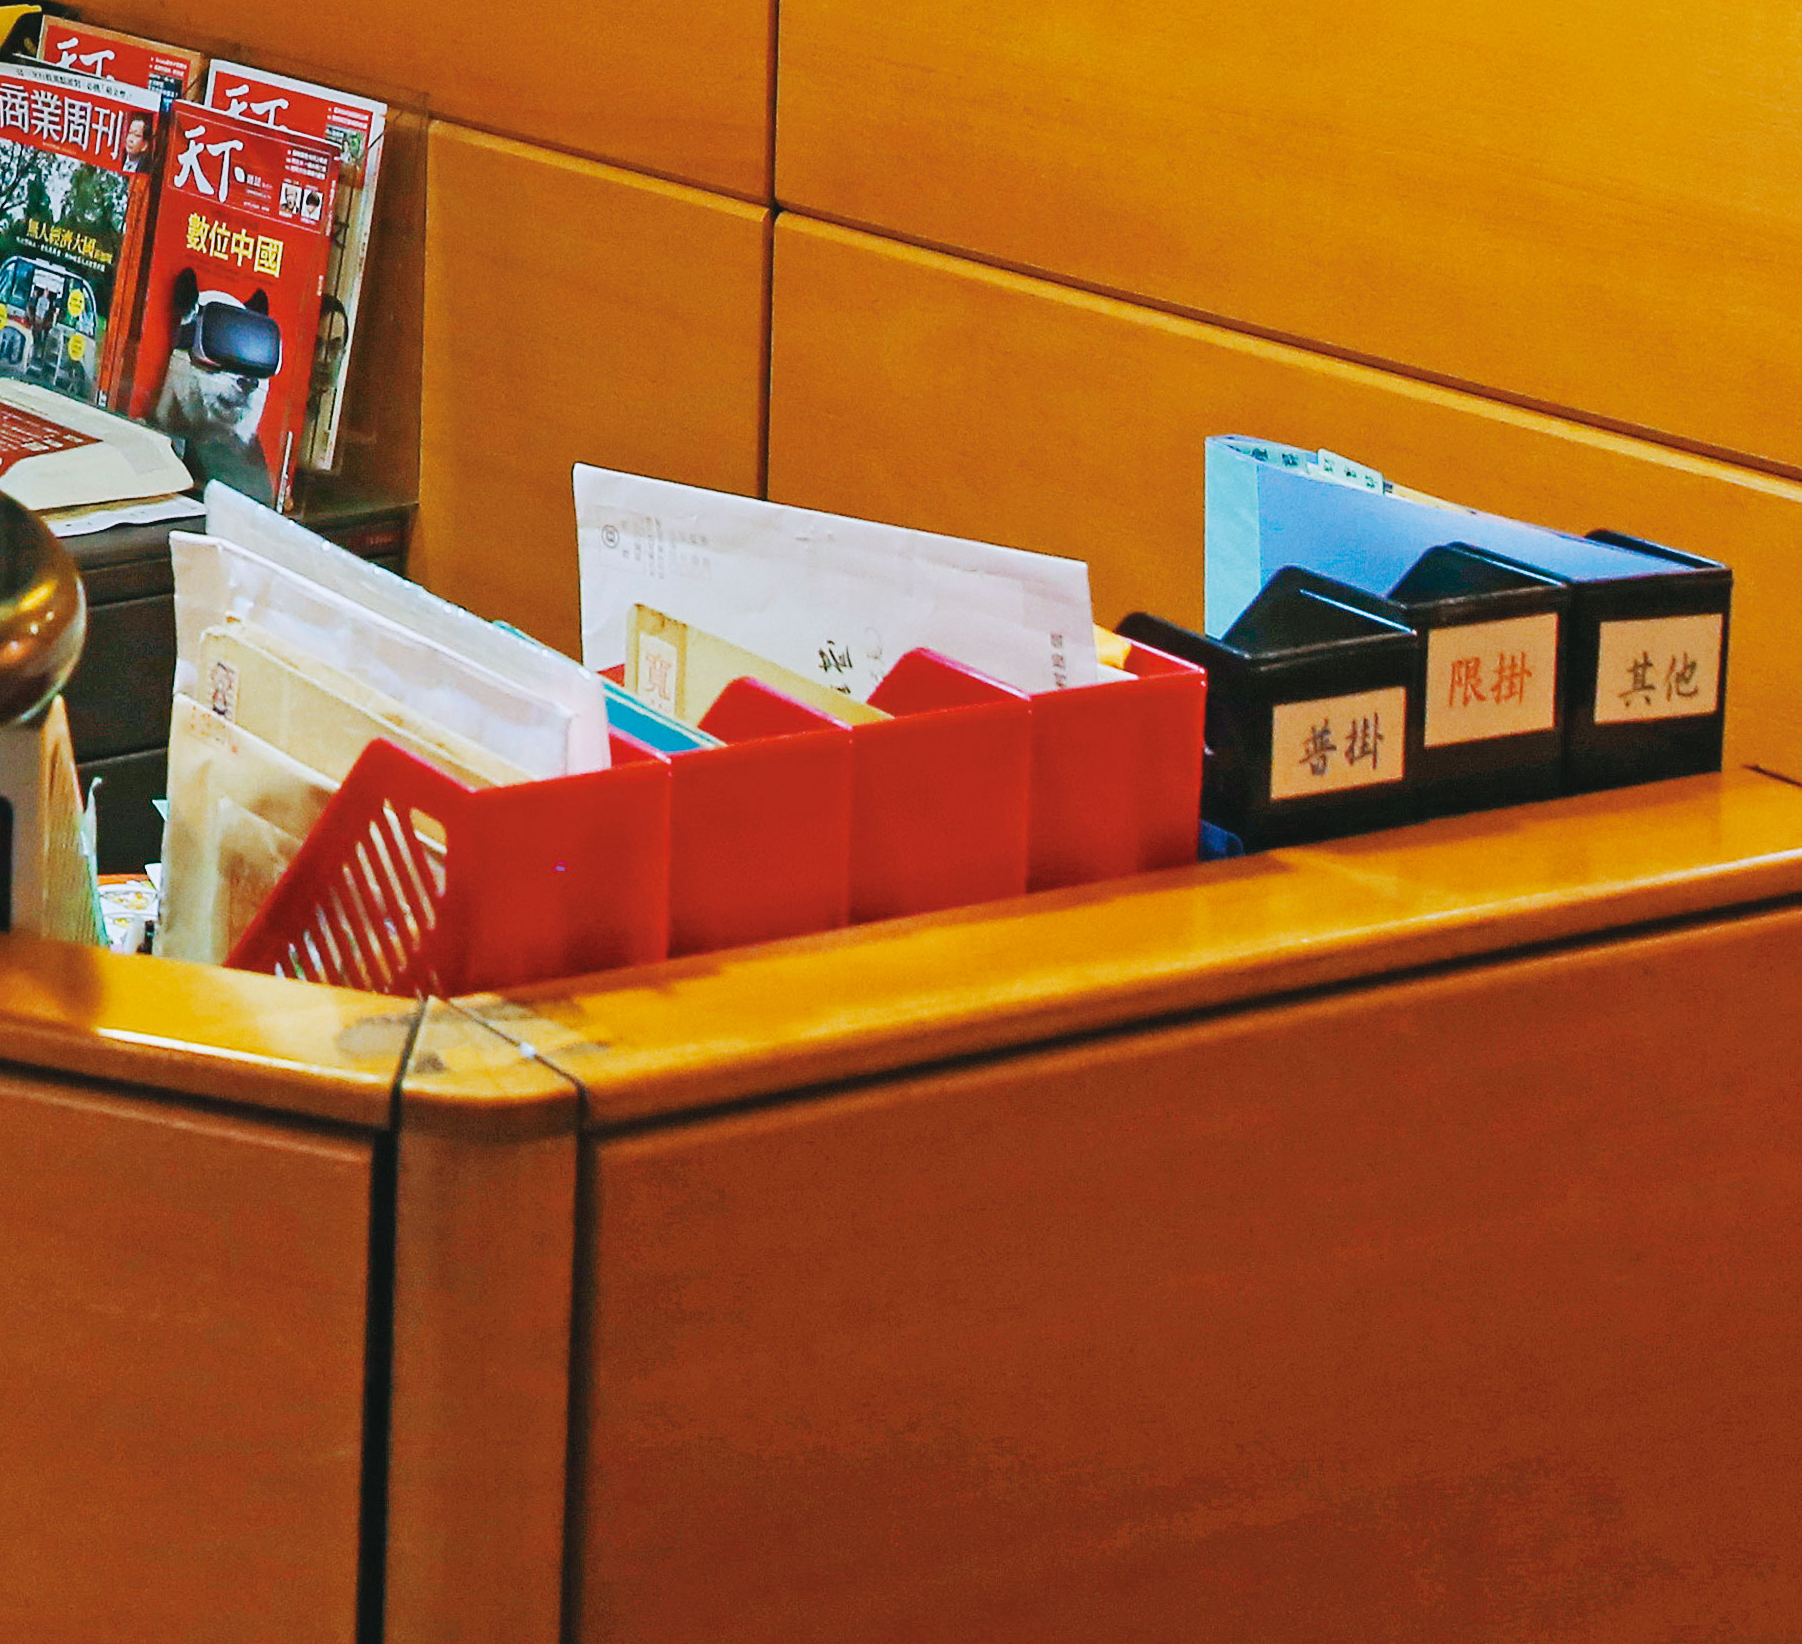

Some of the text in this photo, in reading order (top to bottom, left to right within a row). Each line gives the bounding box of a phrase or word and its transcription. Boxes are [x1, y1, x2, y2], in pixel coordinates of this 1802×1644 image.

[174, 125, 246, 203] 天下
[186, 213, 284, 278] 數位中國
[1448, 652, 1533, 708] 限掛
[1618, 653, 1702, 708] 其他
[1298, 712, 1384, 776] 普掛
